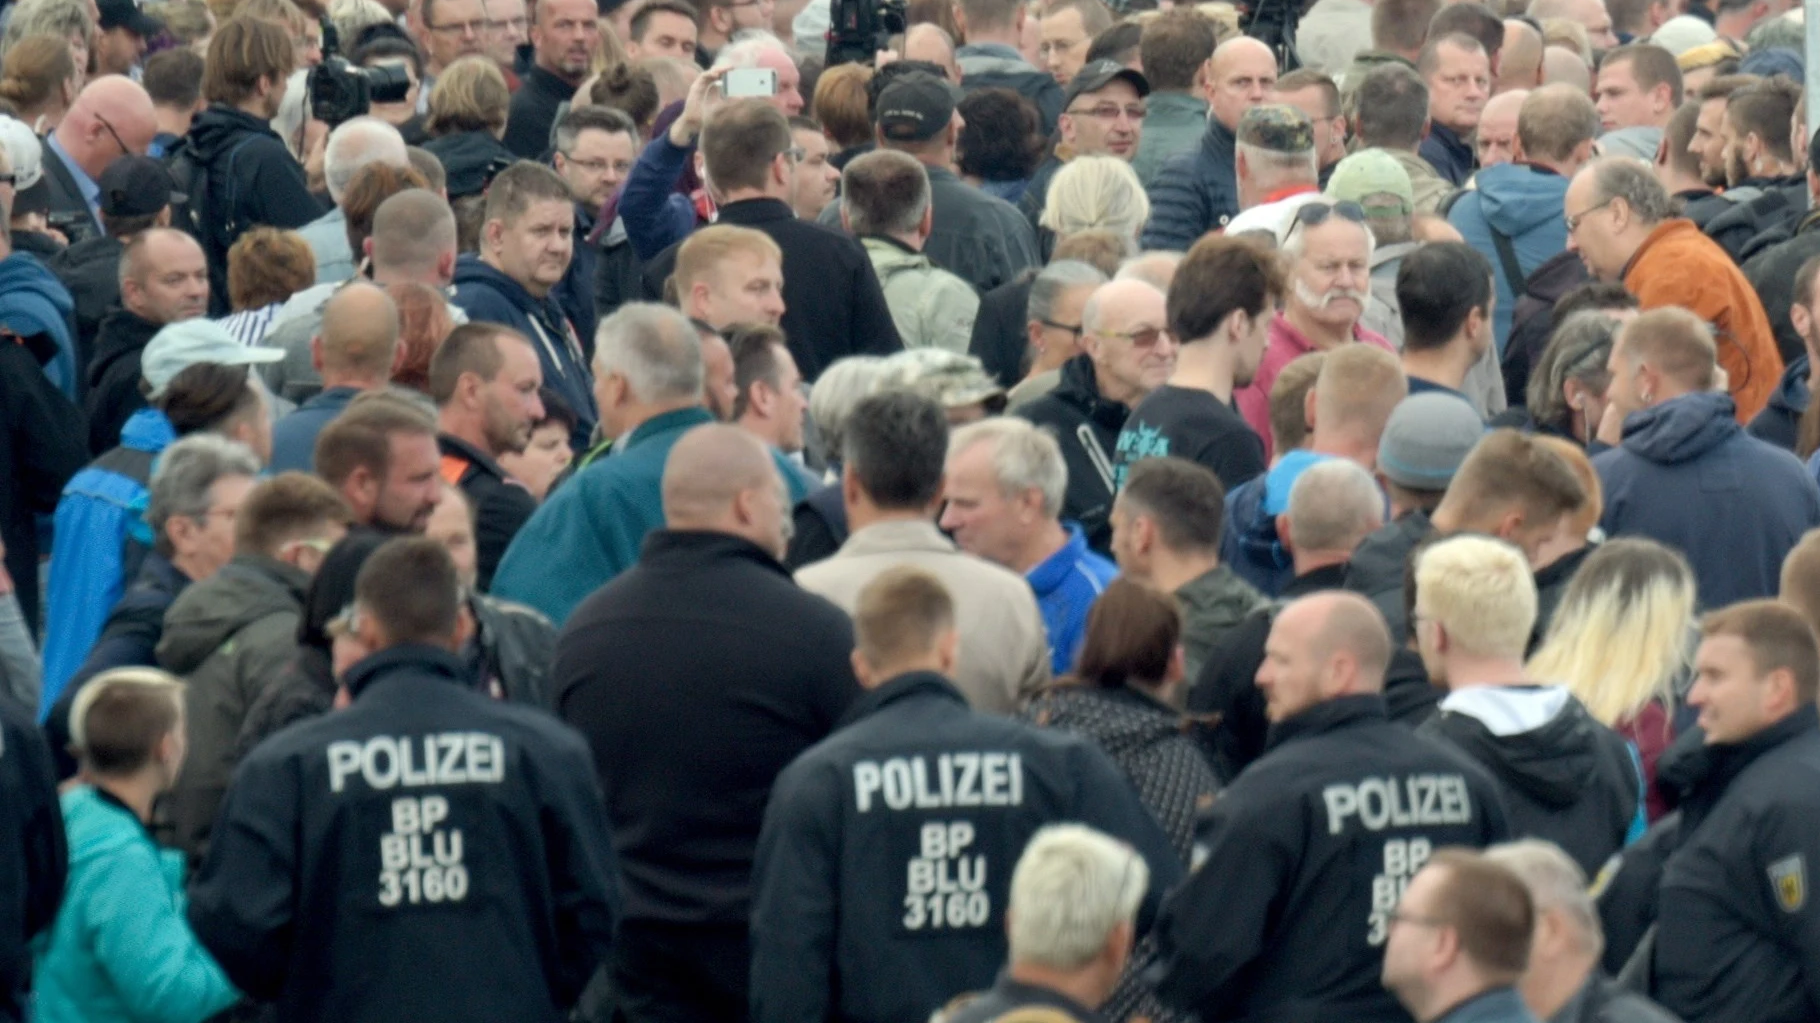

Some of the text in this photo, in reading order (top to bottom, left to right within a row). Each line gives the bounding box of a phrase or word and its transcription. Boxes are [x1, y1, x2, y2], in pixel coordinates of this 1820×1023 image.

[328, 732, 505, 793] POLIZEI
[853, 752, 1024, 813] POLIZEI
[391, 796, 449, 836] BP
[1322, 773, 1473, 834] POLIZEI
[380, 830, 464, 872] BLU
[920, 821, 975, 860] BP
[1383, 837, 1432, 877] BP
[378, 865, 469, 907] 3160
[907, 853, 987, 896] BLU
[902, 890, 990, 931] 3160
